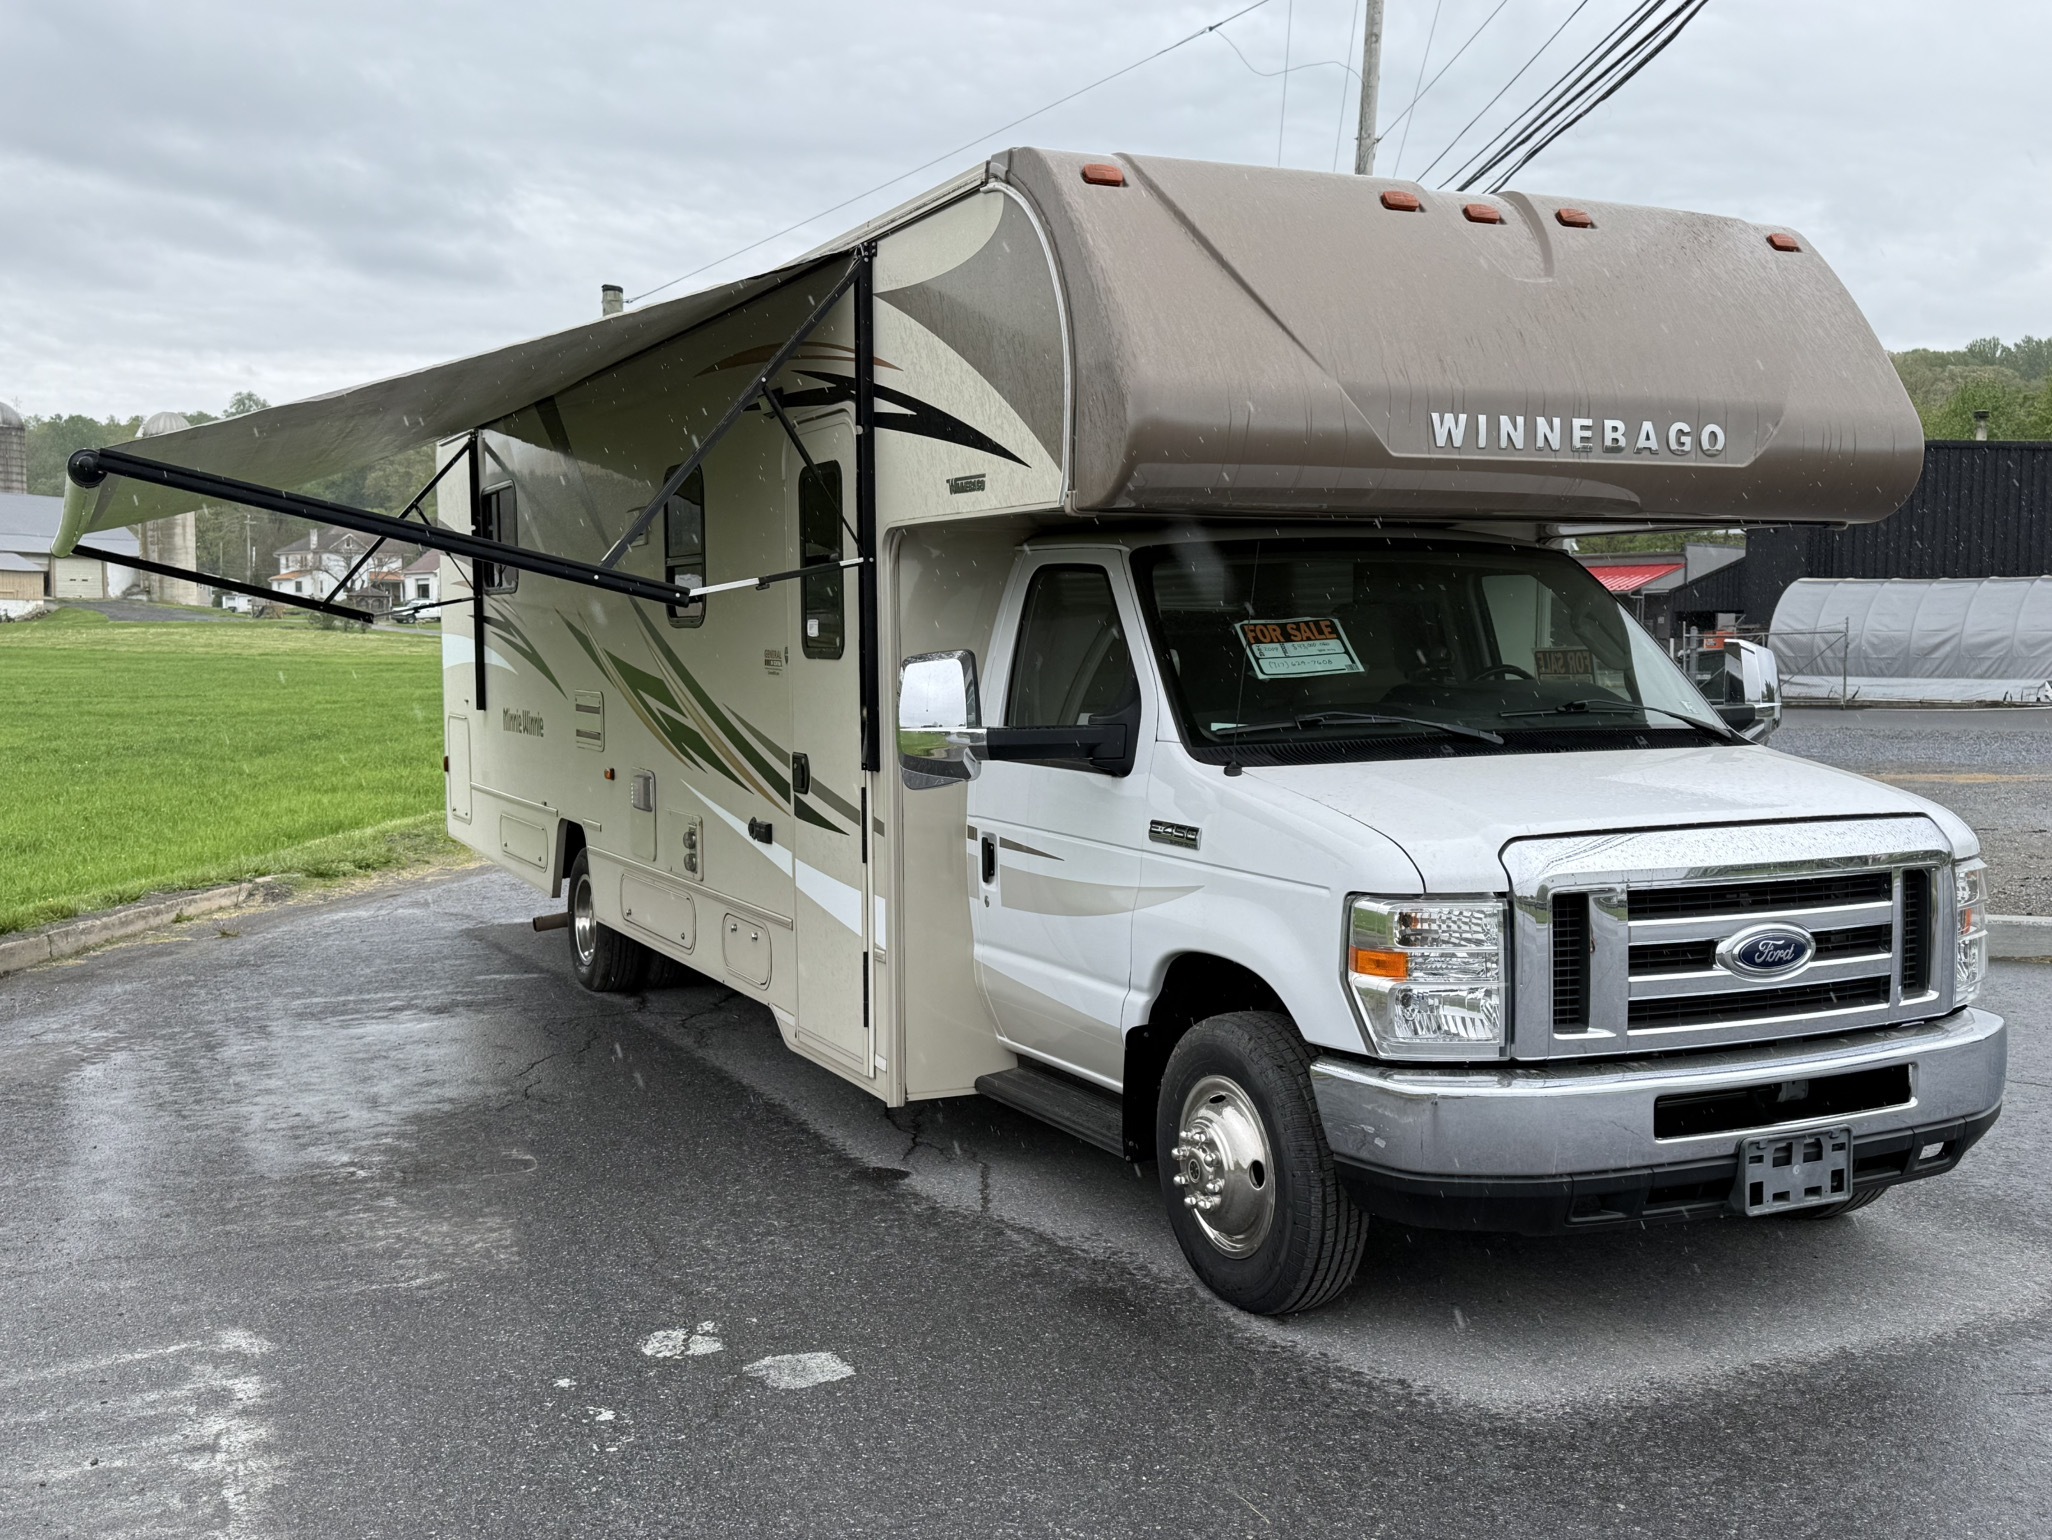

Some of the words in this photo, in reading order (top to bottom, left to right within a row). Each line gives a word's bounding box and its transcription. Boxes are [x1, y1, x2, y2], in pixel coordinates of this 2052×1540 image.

[1431, 413, 1726, 457] WINNEBAGO
[1244, 624, 1285, 644] FOR
[1286, 620, 1337, 641] SALE
[1755, 940, 1795, 963] Ford
